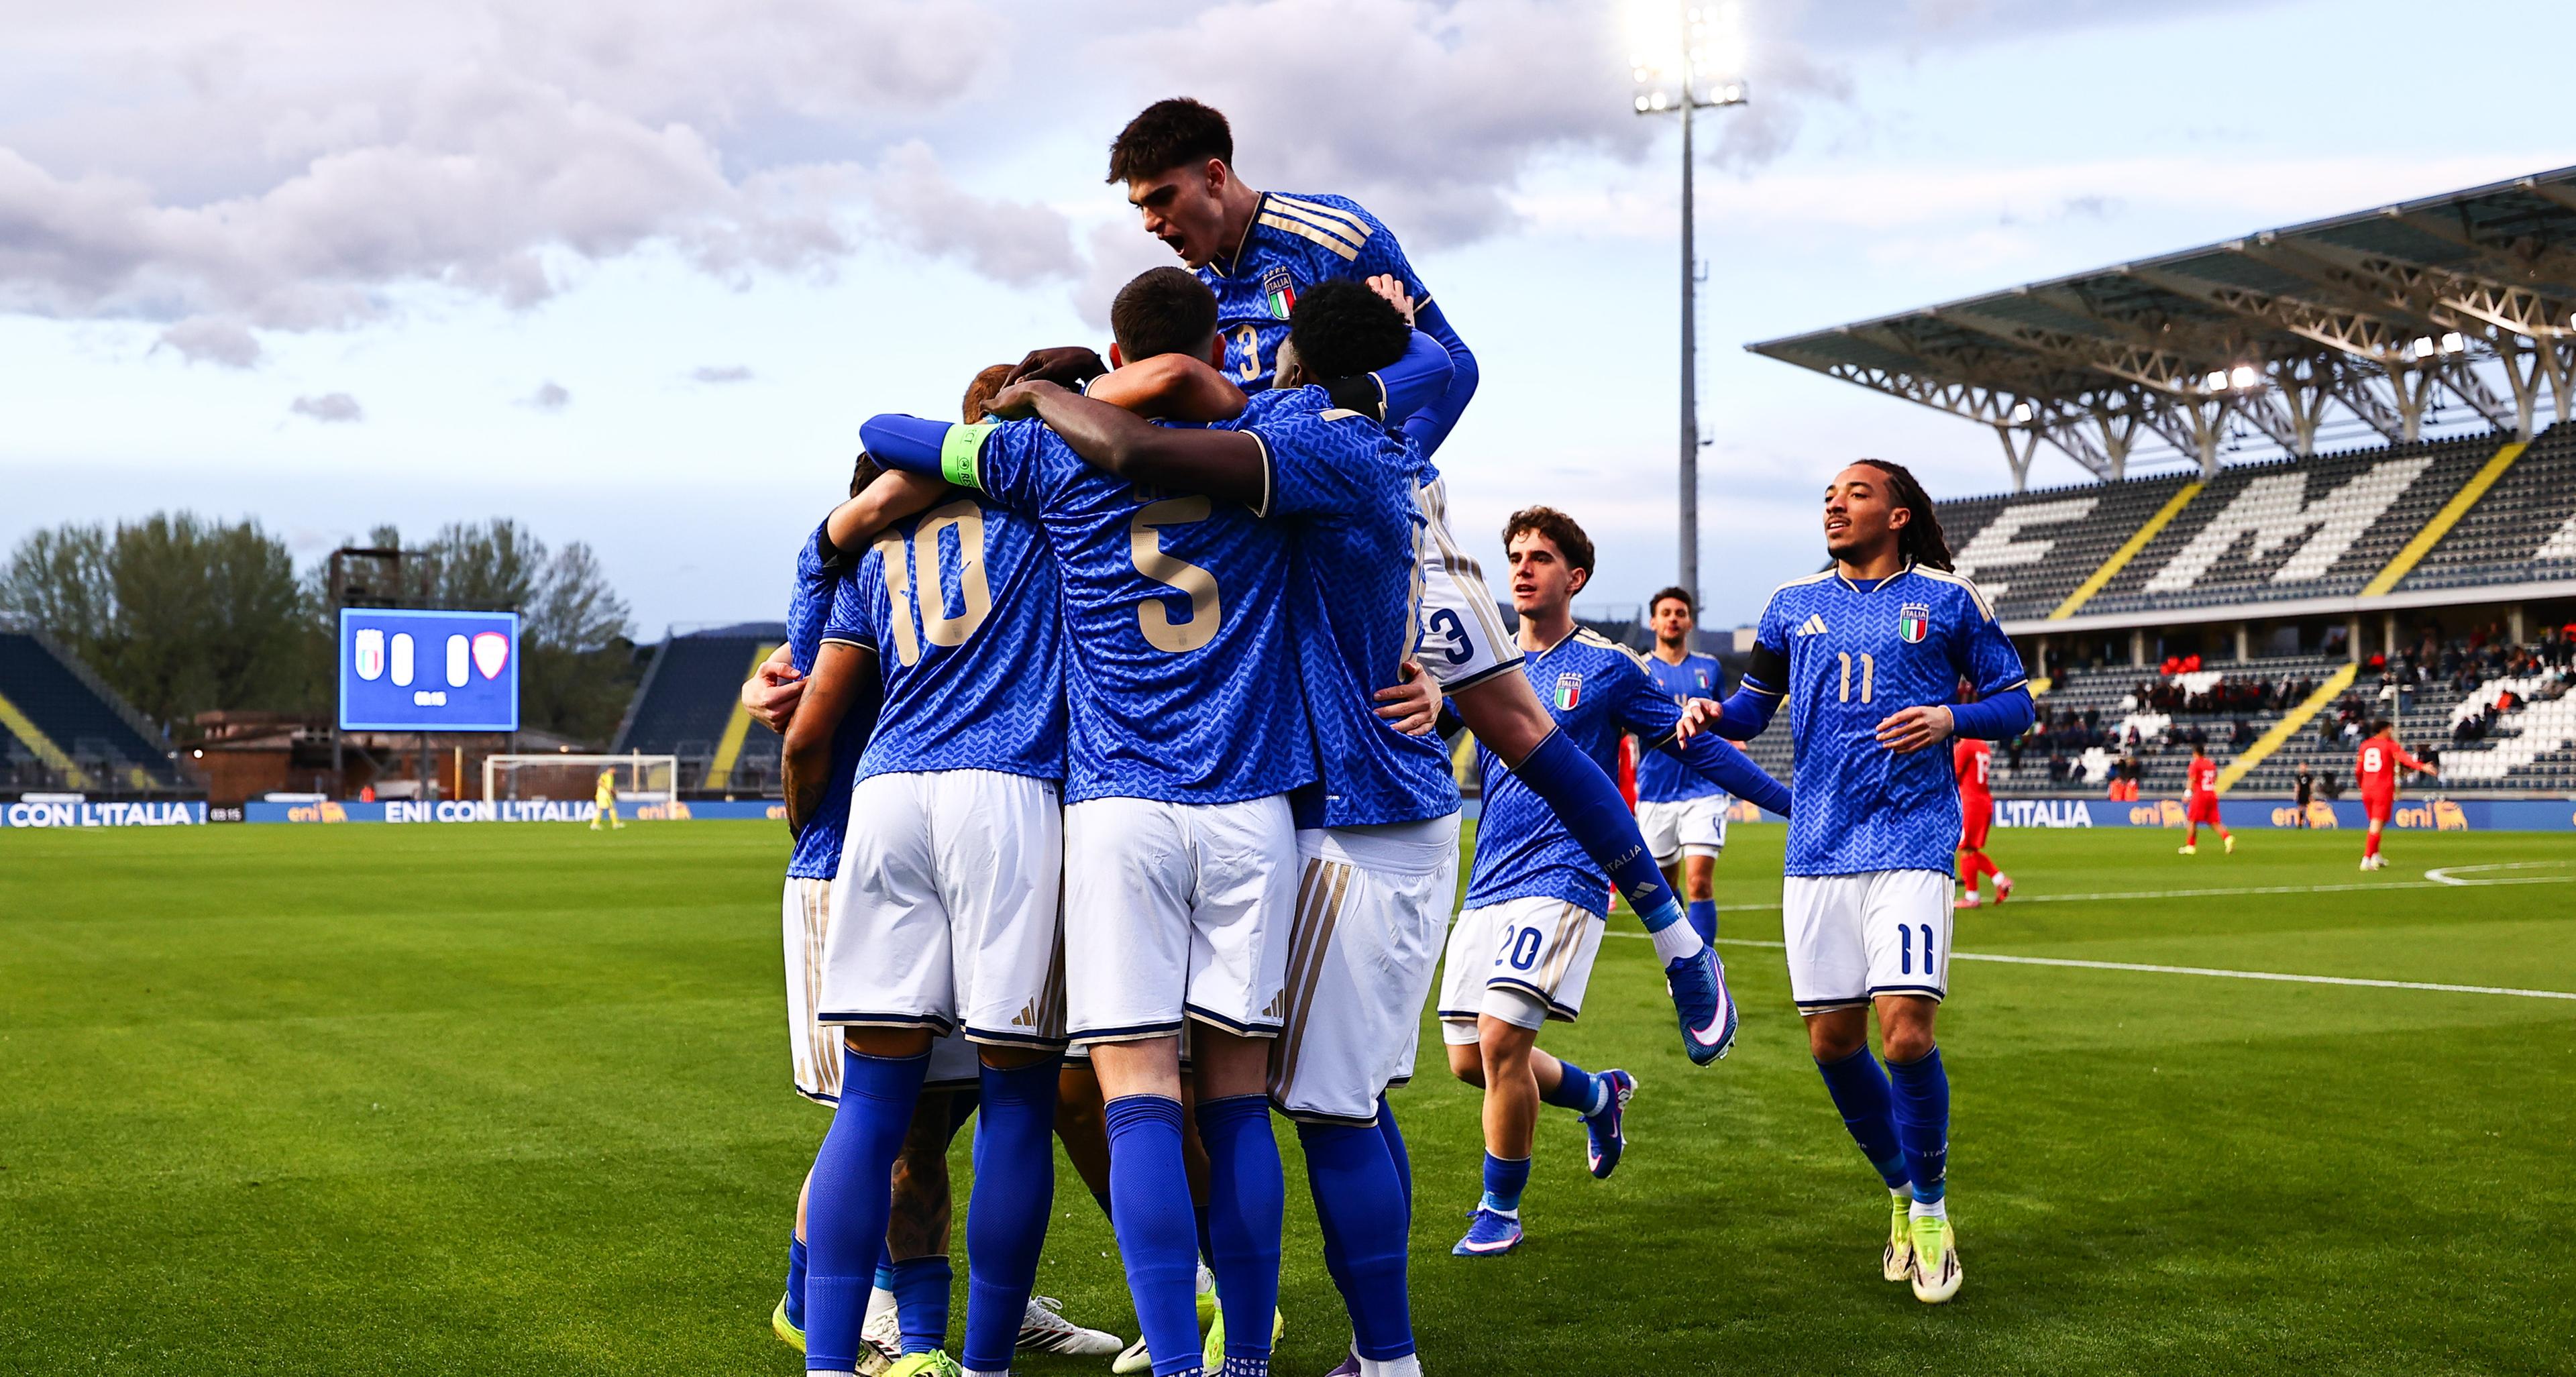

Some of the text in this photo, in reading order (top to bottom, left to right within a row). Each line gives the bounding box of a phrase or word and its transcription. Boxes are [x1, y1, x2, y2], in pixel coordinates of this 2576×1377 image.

[1267, 276, 1289, 292] ITALIA
[1237, 325, 1260, 381] 3
[873, 499, 993, 667] 10
[1130, 494, 1221, 652] 5
[1902, 610, 1927, 618] ITALIA
[1430, 608, 1474, 665] 3
[1559, 679, 1579, 687] ITALIA
[1838, 652, 1874, 704] 11
[2363, 747, 2381, 772] 8
[8, 803, 74, 826] CON
[81, 802, 193, 826] L'ITALIA
[287, 802, 321, 822] eni
[385, 800, 596, 822] ENI CON L'ITALIA
[637, 803, 665, 820] eni
[766, 805, 787, 819] en
[1995, 800, 2092, 828] L'ITALIA
[2129, 802, 2160, 826] eni
[2395, 802, 2432, 828] eni
[1604, 844, 1642, 873] ITALIA
[1495, 925, 1542, 971] 20
[1898, 924, 1933, 975] 11
